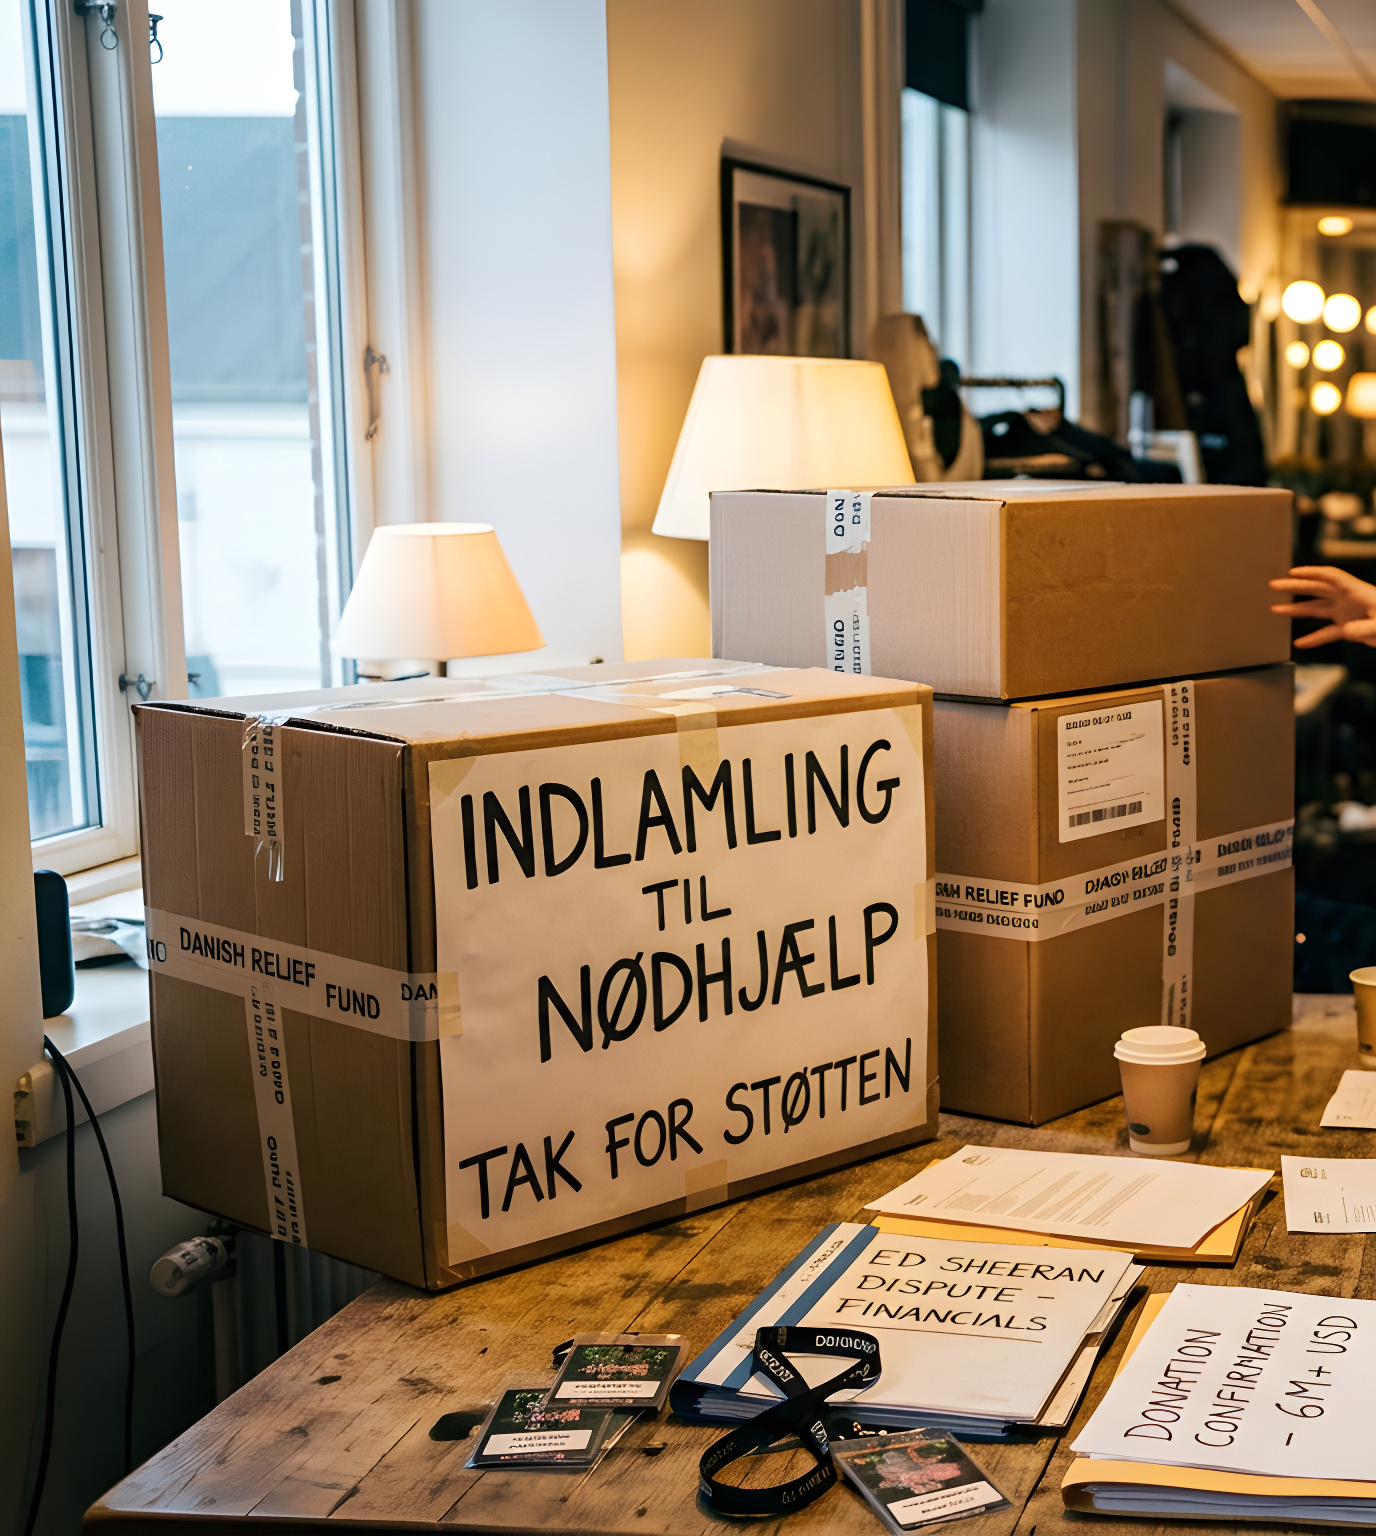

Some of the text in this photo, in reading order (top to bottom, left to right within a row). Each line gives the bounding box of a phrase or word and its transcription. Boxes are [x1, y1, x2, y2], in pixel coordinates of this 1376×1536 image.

[460, 738, 901, 890] INDLAMLING
[641, 875, 732, 931] TIL
[965, 885, 1019, 908] RELIEF
[179, 926, 246, 968] DANISH
[251, 947, 316, 987] RELIEF
[325, 983, 380, 1020] FUND
[537, 902, 899, 1064] NØDHJÆLP
[458, 1037, 912, 1219] TAK FOR STØTTEN
[856, 1274, 1023, 1303] DISPUTE
[868, 1249, 926, 1267] ED
[939, 1256, 1105, 1284] SHEERAN
[835, 1297, 1048, 1331] FINANCIALS
[1305, 1314, 1358, 1355] USD
[1123, 1328, 1222, 1442] DONATION
[1194, 1303, 1293, 1448] CONFIRMATION
